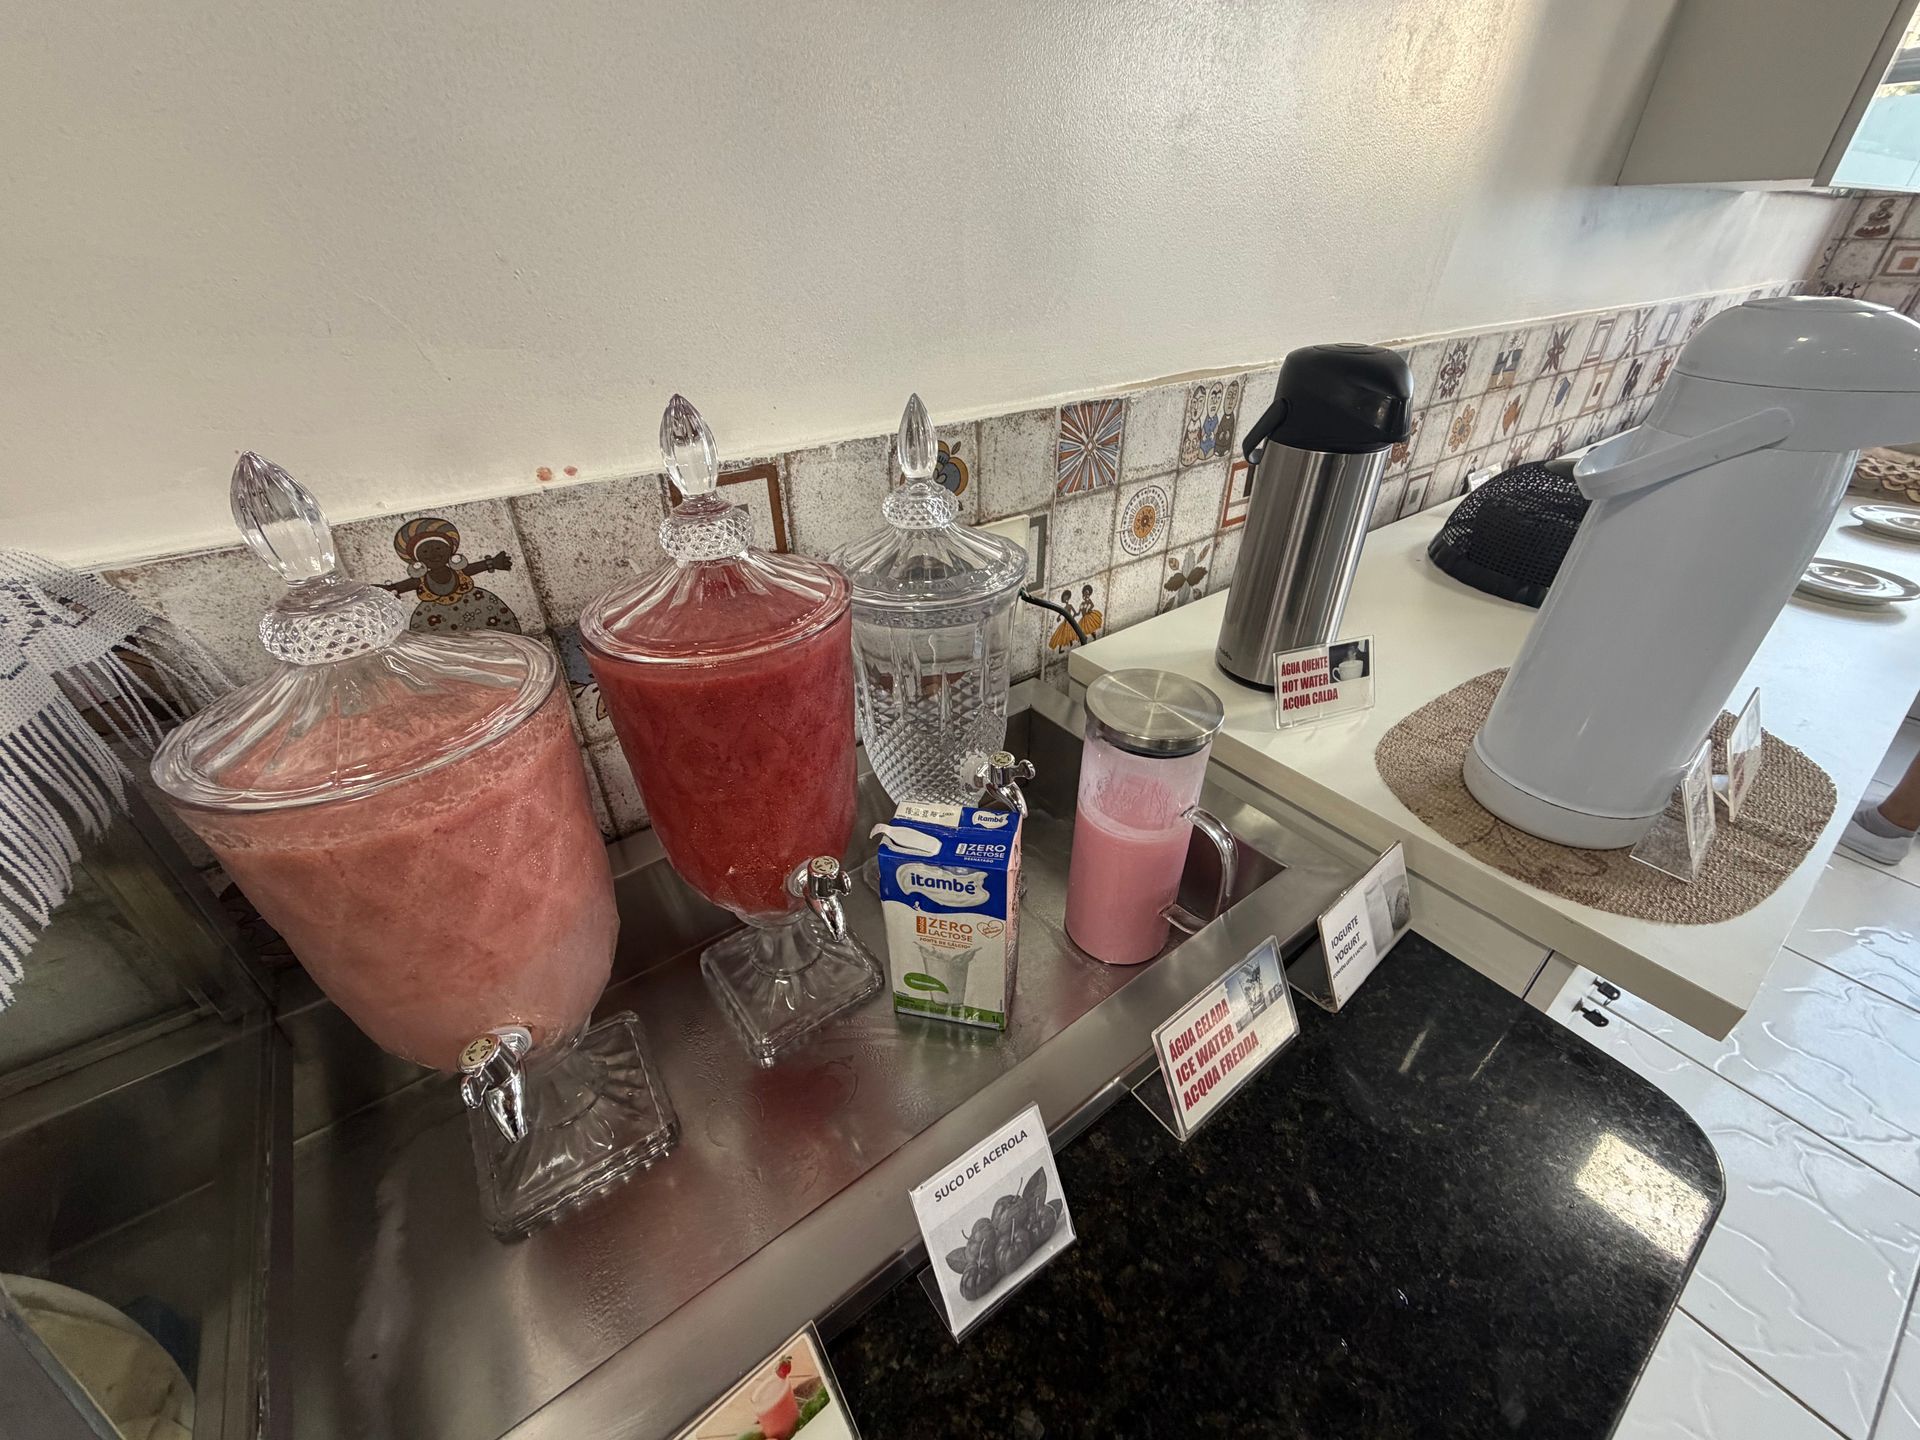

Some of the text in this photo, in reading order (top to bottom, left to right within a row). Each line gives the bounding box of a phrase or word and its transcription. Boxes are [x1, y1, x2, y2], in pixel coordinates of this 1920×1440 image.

[1281, 656, 1328, 677] ÁGUA QUENTE
[1282, 673, 1329, 694] HOT WATER
[1282, 688, 1338, 711] ACQUA CALDA
[977, 813, 1004, 824] itambé
[965, 850, 1005, 859] LACTOSE
[968, 843, 1006, 853] ZERO
[911, 872, 976, 895] itambé
[928, 917, 973, 935] ZERO
[928, 929, 973, 943] LACTOSE
[1331, 914, 1359, 949] IOGURTE
[1335, 931, 1361, 963] YOGURT
[1169, 997, 1231, 1063] ÁGUA GELADA
[1175, 1023, 1235, 1087] ICE WATER
[1183, 1030, 1259, 1111] ACQUA FREDDA
[934, 1129, 1028, 1203] SUCO DE ACEROLA
